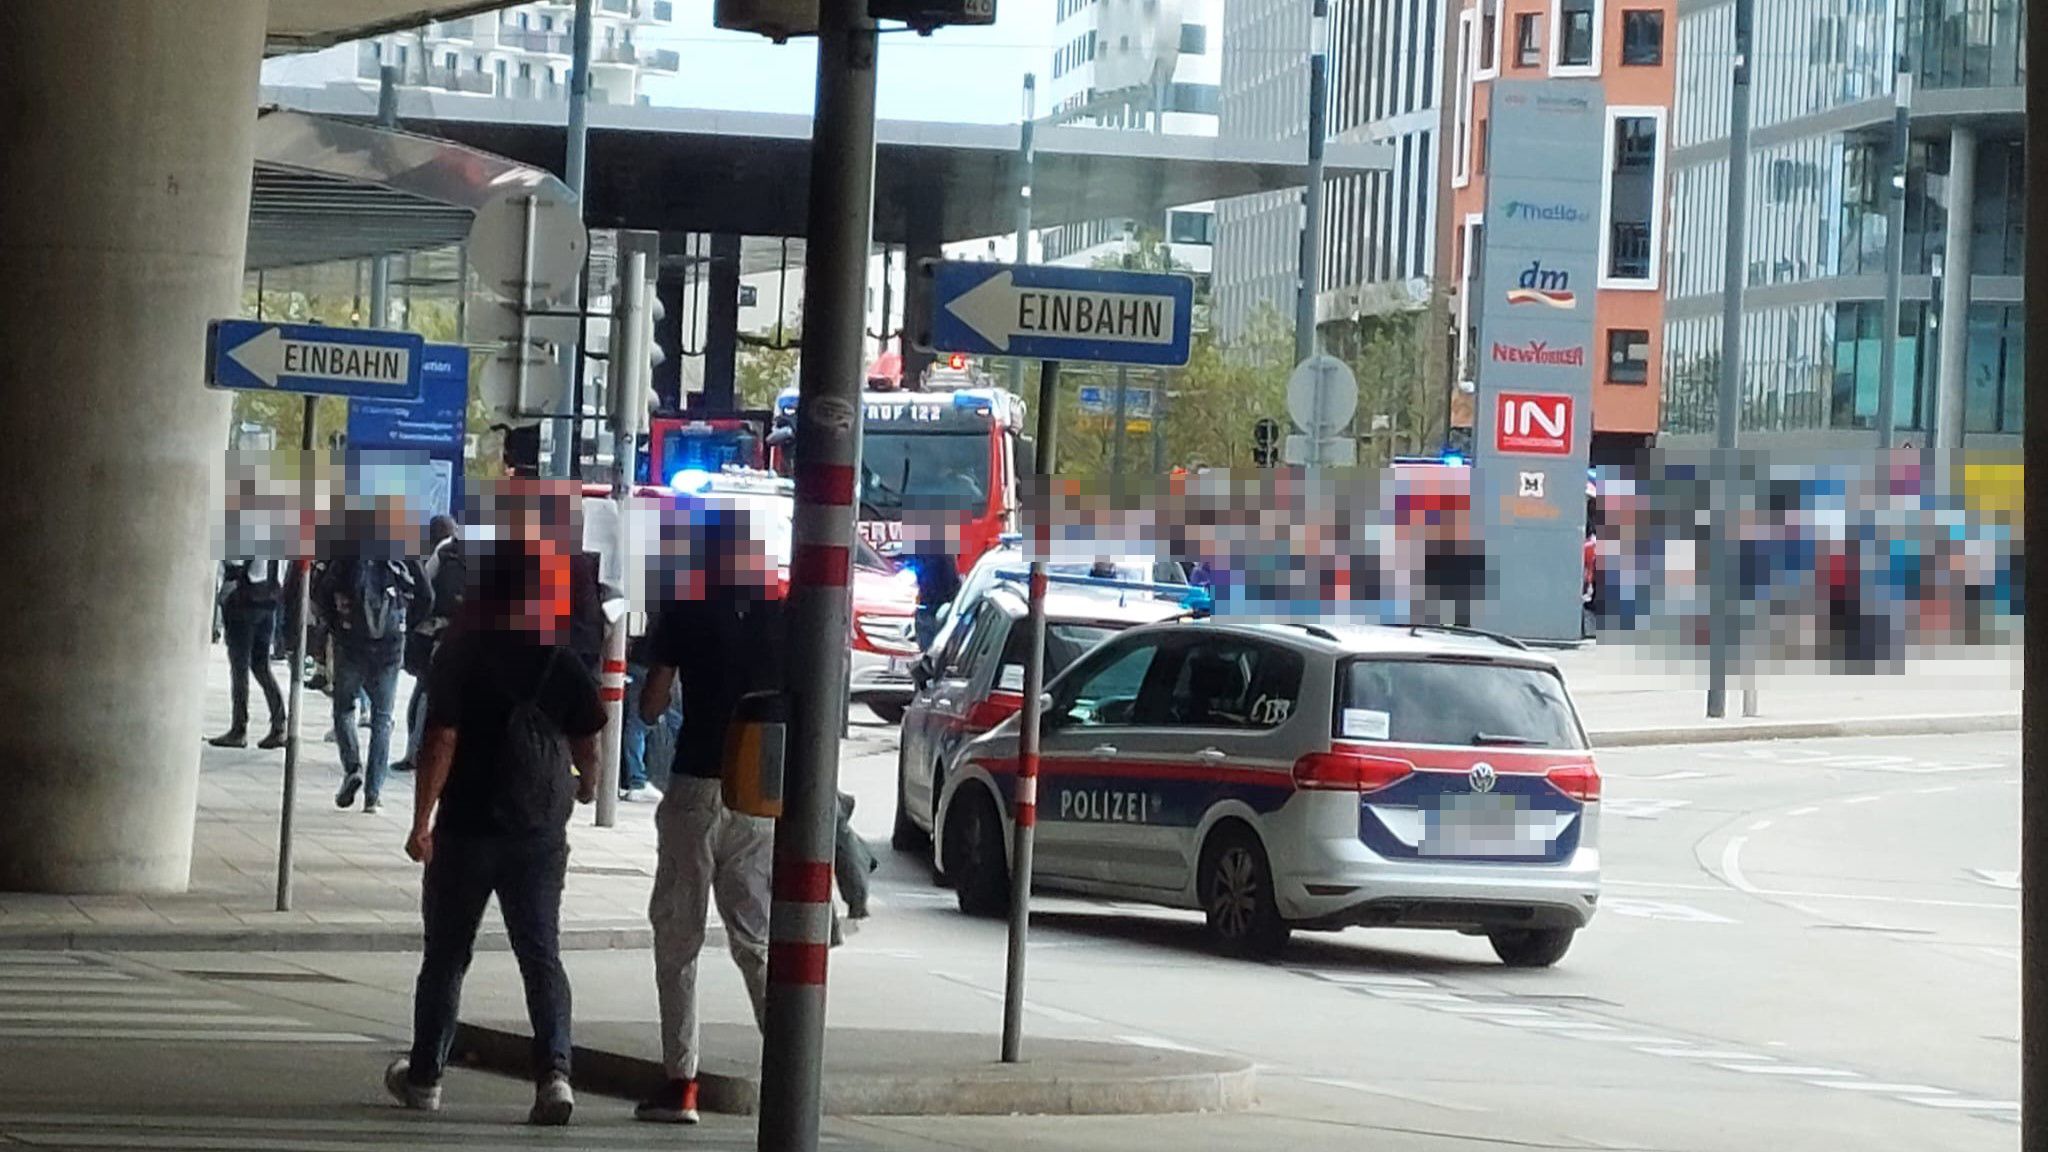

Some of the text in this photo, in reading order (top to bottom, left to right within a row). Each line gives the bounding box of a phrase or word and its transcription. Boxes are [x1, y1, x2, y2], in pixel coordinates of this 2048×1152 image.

[1519, 260, 1568, 290] dm
[1018, 293, 1162, 337] EINBAHN
[284, 344, 399, 379] EINBAHN
[911, 404, 941, 421] 122
[1504, 400, 1565, 437] IN
[1061, 790, 1147, 822] POLIZEI
